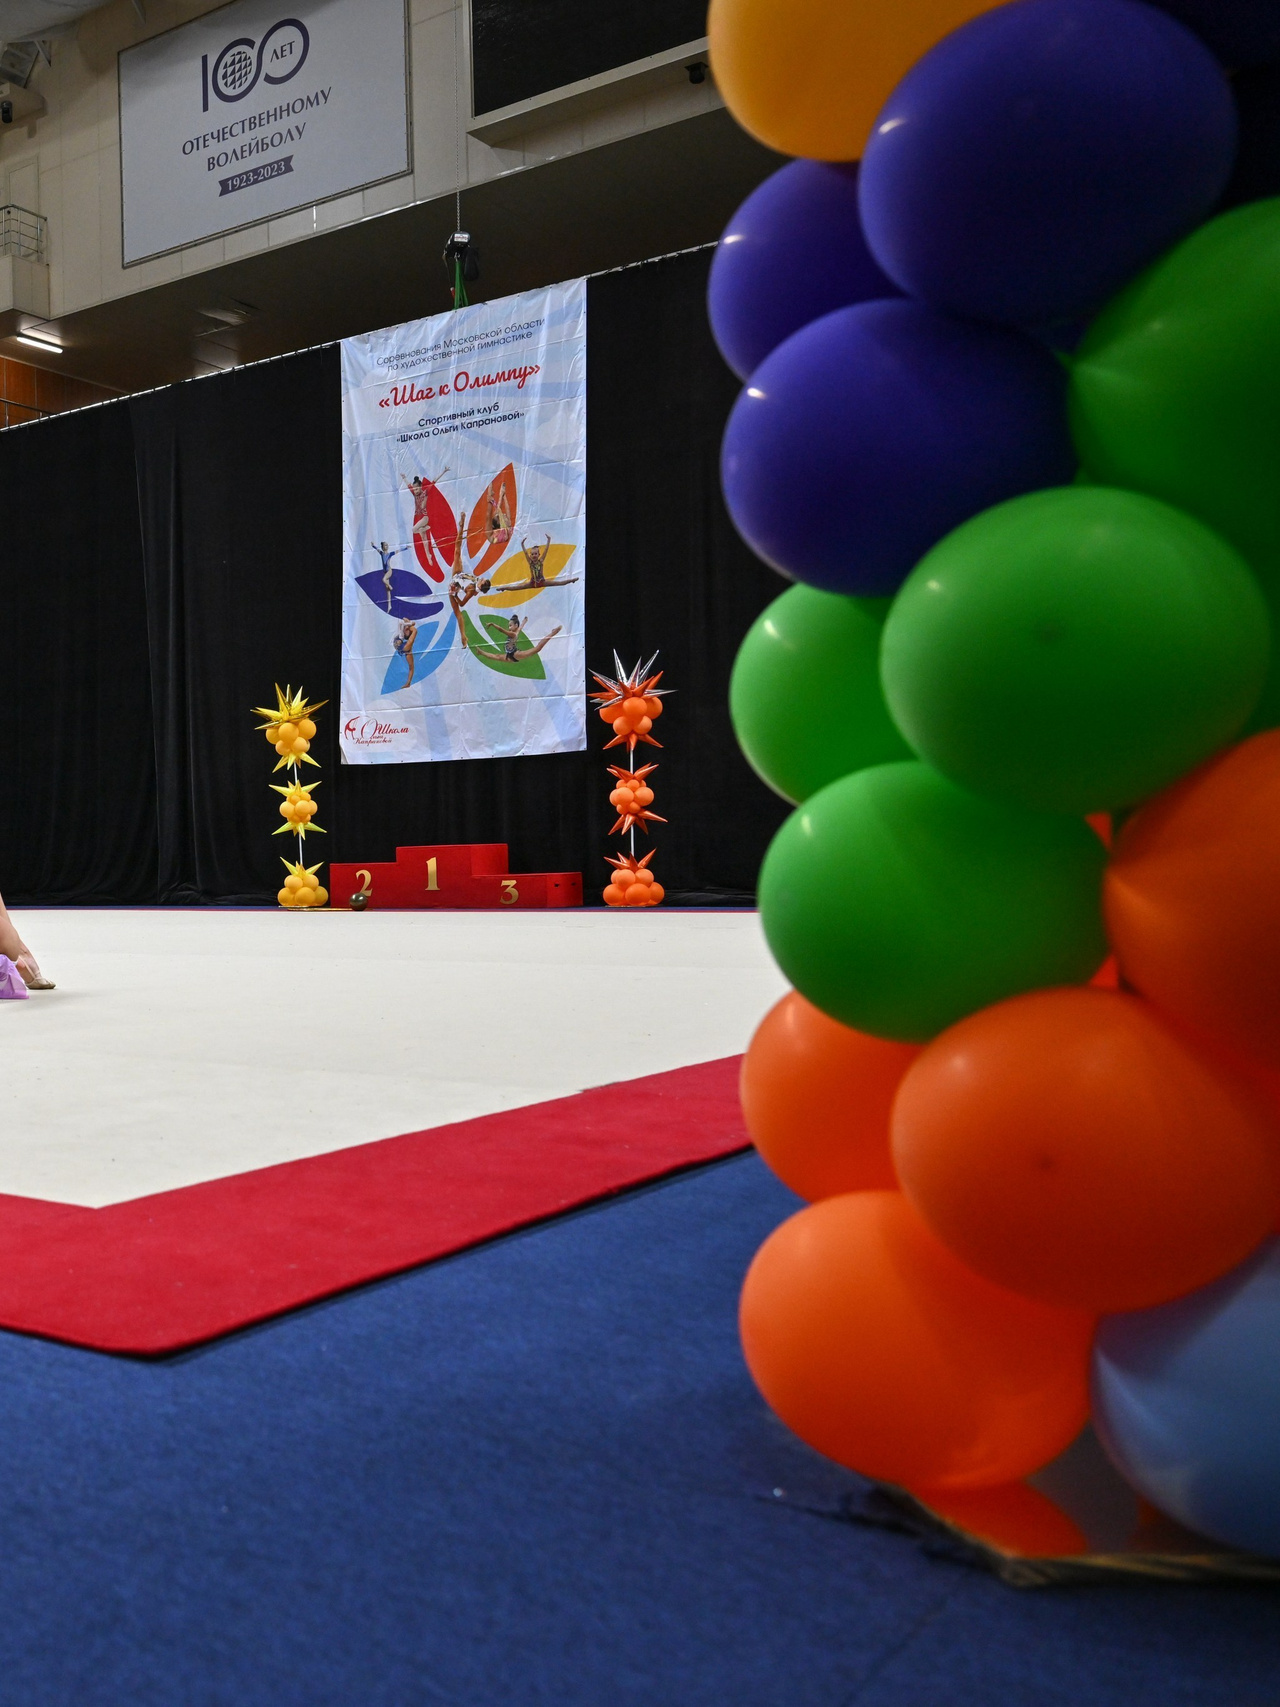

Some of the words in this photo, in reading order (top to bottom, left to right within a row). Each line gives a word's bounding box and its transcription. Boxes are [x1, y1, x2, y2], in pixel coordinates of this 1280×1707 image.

[270, 40, 296, 63] ЛЕТ
[181, 86, 332, 155] ОТЕЧЕСТВЕННОМУ
[206, 122, 307, 172] ВОЛЕЙБОЛУ
[226, 161, 286, 191] 1923-2023
[376, 342, 442, 366] Соревнования
[443, 327, 502, 348] Московской
[504, 318, 546, 334] области
[387, 363, 399, 373] по
[400, 343, 476, 370] художественной
[477, 330, 533, 350] гимнастике
[378, 383, 437, 408] «Шаг
[438, 383, 451, 397] к
[453, 364, 541, 390] Олимпу»
[418, 408, 475, 427] Спортивный
[476, 402, 500, 417] клуб
[431, 423, 459, 436] Ольги
[355, 869, 373, 897] 2
[424, 856, 441, 891] 1
[499, 879, 519, 905] 3
